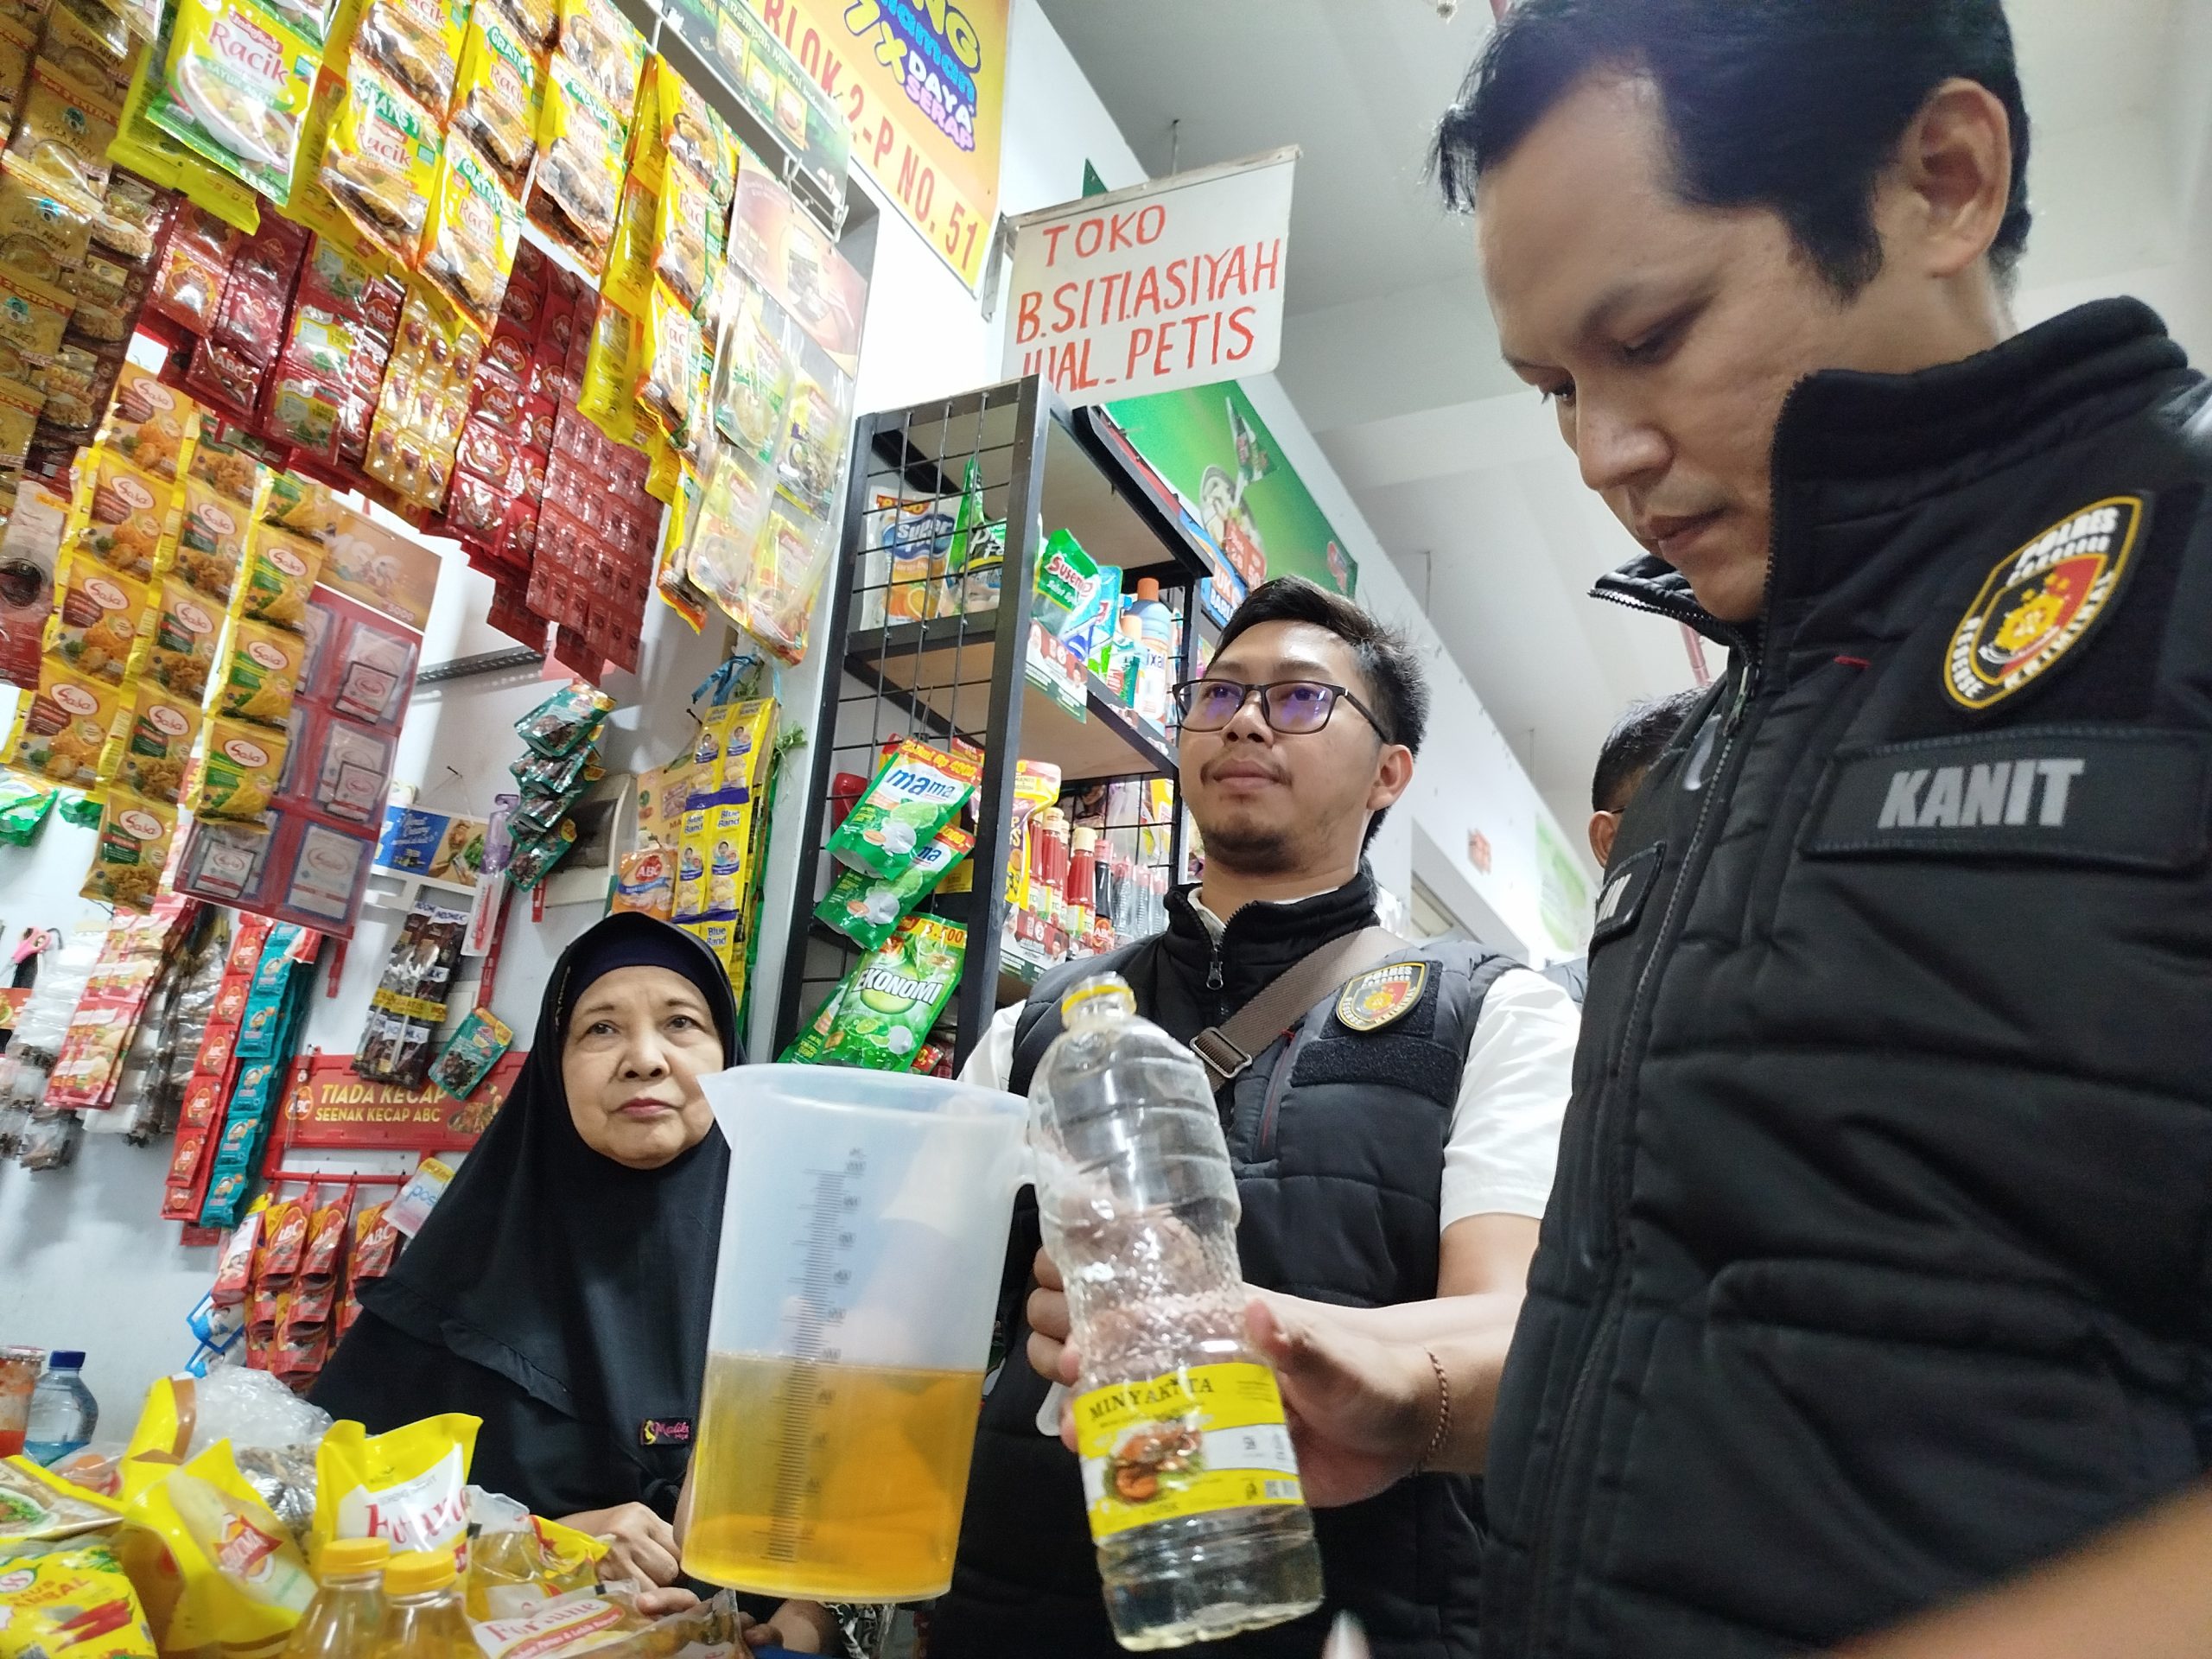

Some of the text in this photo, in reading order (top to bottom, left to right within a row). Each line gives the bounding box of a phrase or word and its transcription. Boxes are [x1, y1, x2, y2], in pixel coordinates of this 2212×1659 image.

[209, 21, 289, 86] Racik
[729, 3, 771, 54] Rempah
[773, 48, 803, 89] Murni
[242, 85, 276, 107] ASM
[908, 50, 973, 133] DAYA
[906, 73, 975, 149] SERAP
[358, 123, 412, 168] Racik
[897, 144, 936, 234] NO.
[945, 200, 978, 272] 51
[1042, 204, 1166, 268] TOKO
[365, 305, 395, 329] ABC
[495, 342, 520, 363] ABC
[1125, 306, 1256, 381] PETIS
[215, 353, 245, 379] ABC
[353, 360, 378, 383] ABC
[487, 393, 512, 413] ABC
[119, 480, 149, 505] Sasa
[204, 507, 231, 531] Sasa
[897, 518, 953, 540] Super
[89, 582, 122, 606] Sasa
[181, 607, 208, 629] Sasa
[57, 686, 92, 710] Sasa
[154, 709, 182, 732] Sasa
[230, 742, 262, 764] Sasa
[932, 753, 950, 768] Rp
[886, 769, 957, 798] mama
[1878, 758, 2086, 830] KANIT
[125, 813, 156, 836] Sasa
[717, 817, 741, 829] Band
[721, 809, 741, 820] Blue
[683, 823, 704, 834] Band
[635, 865, 660, 878] ABC
[708, 926, 727, 936] Blue
[851, 967, 944, 1006] EKONOMI
[192, 1100, 209, 1110] ABC
[321, 1084, 449, 1104] TIADA KECAP
[315, 1107, 442, 1122] SEENAK KECAP ABC
[364, 1224, 391, 1246] ABC
